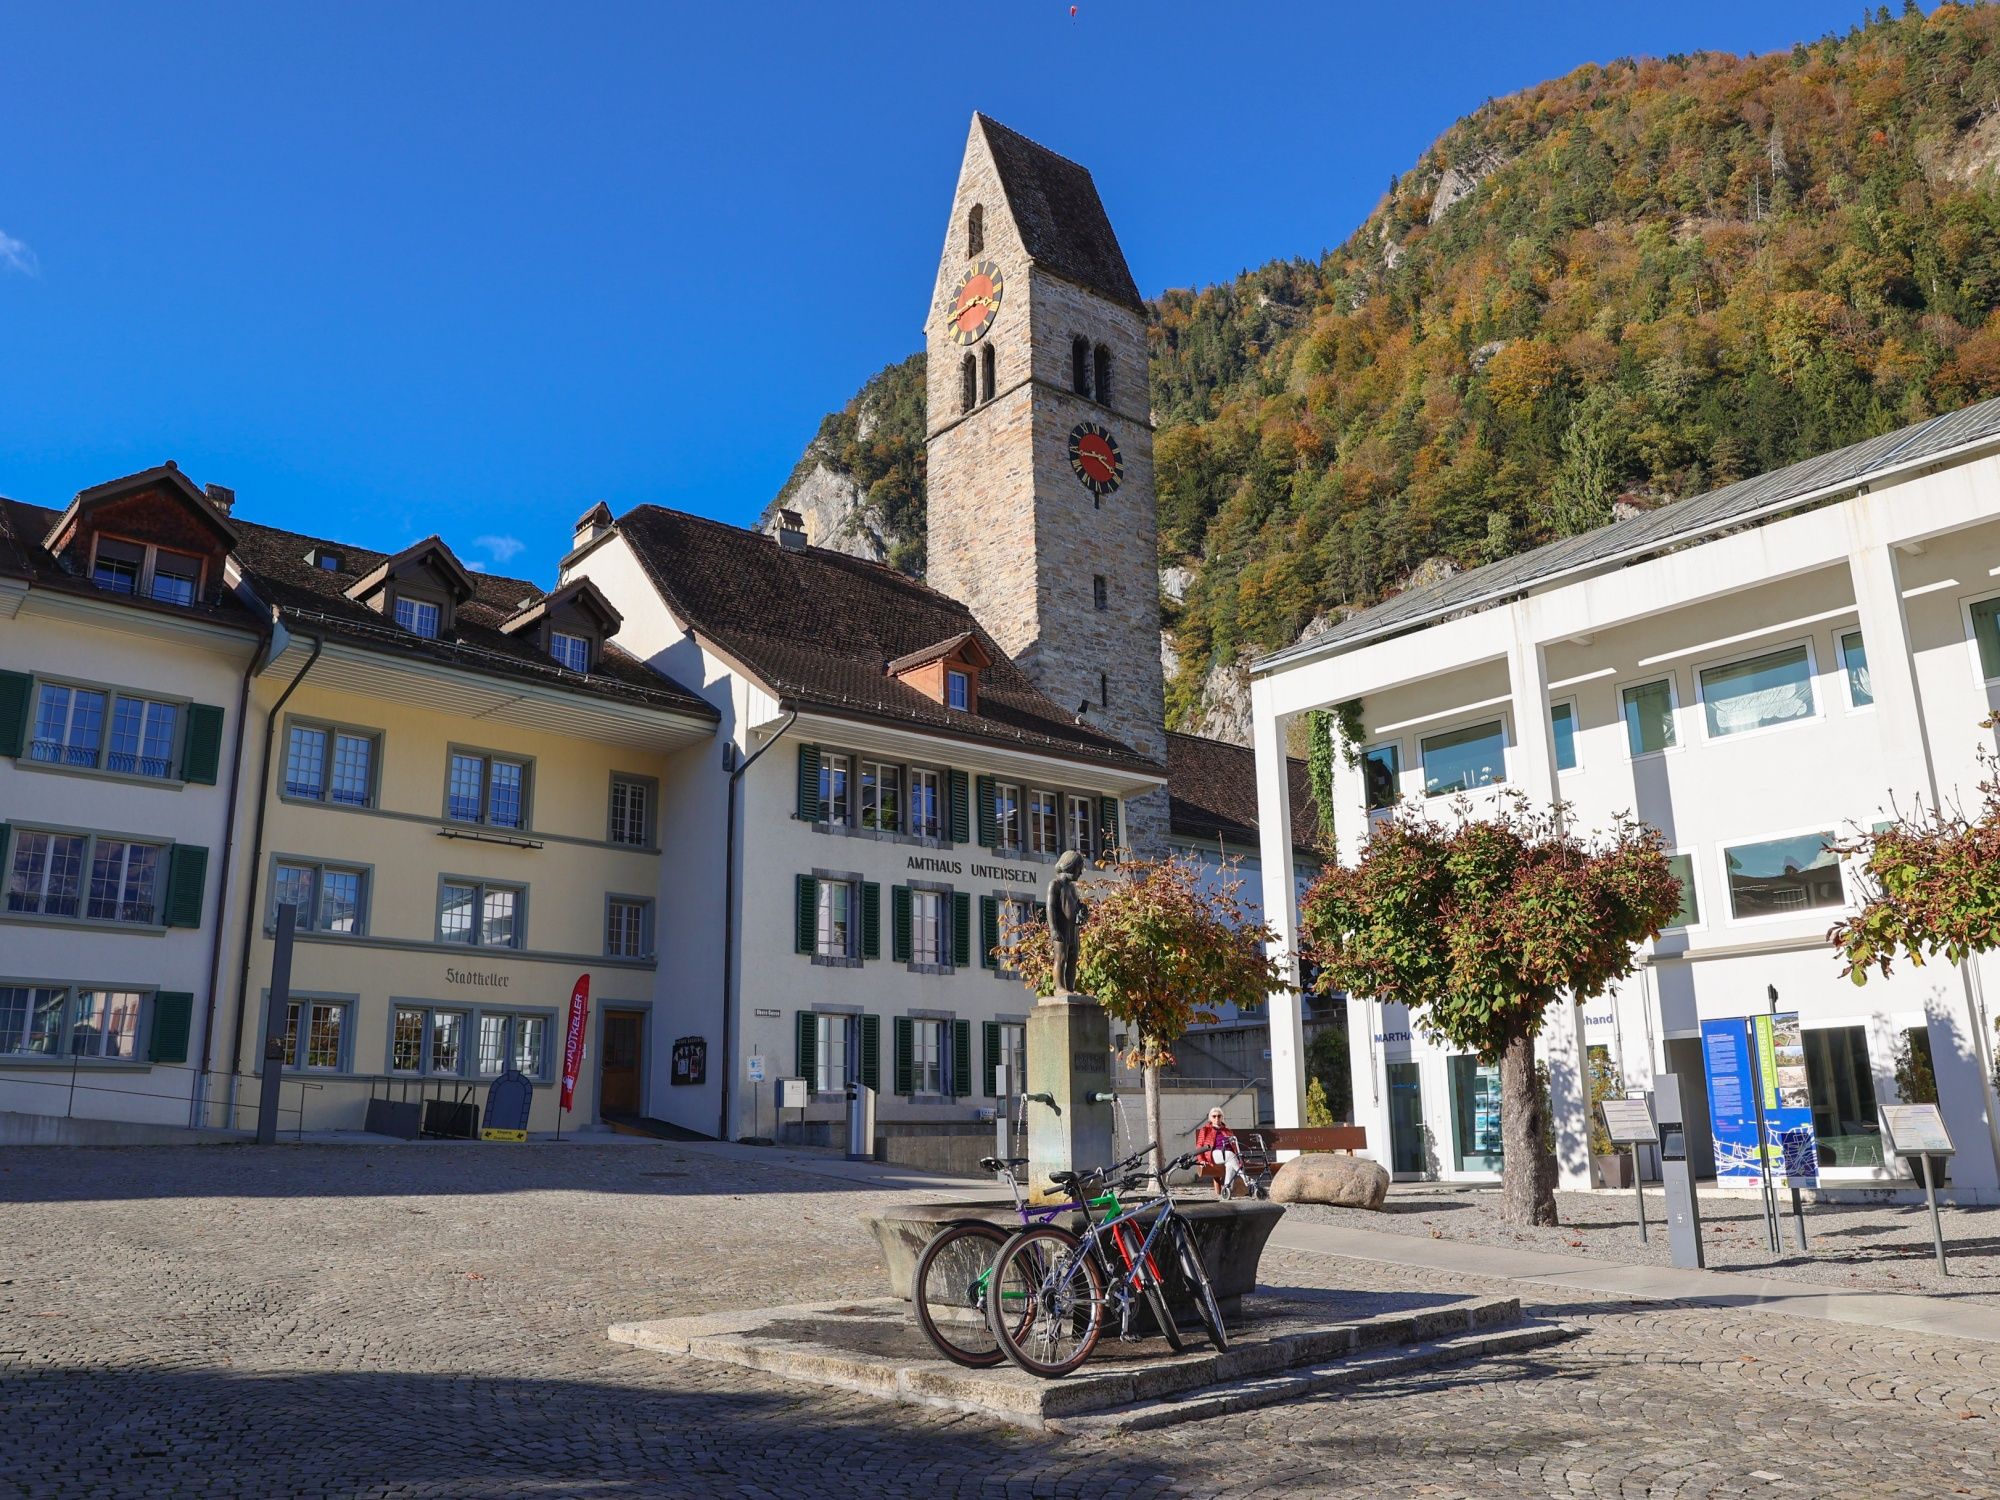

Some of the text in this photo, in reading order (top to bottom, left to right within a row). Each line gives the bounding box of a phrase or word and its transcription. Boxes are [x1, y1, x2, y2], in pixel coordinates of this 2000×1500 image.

[907, 855, 1037, 884] AMTHAUS UNTERSEEN
[445, 967, 510, 988] Stadtkeller
[1583, 1013, 1614, 1026] hand
[1374, 1031, 1415, 1043] MARTHA
[1758, 1022, 1774, 1105] STADT UNTERSEEN
